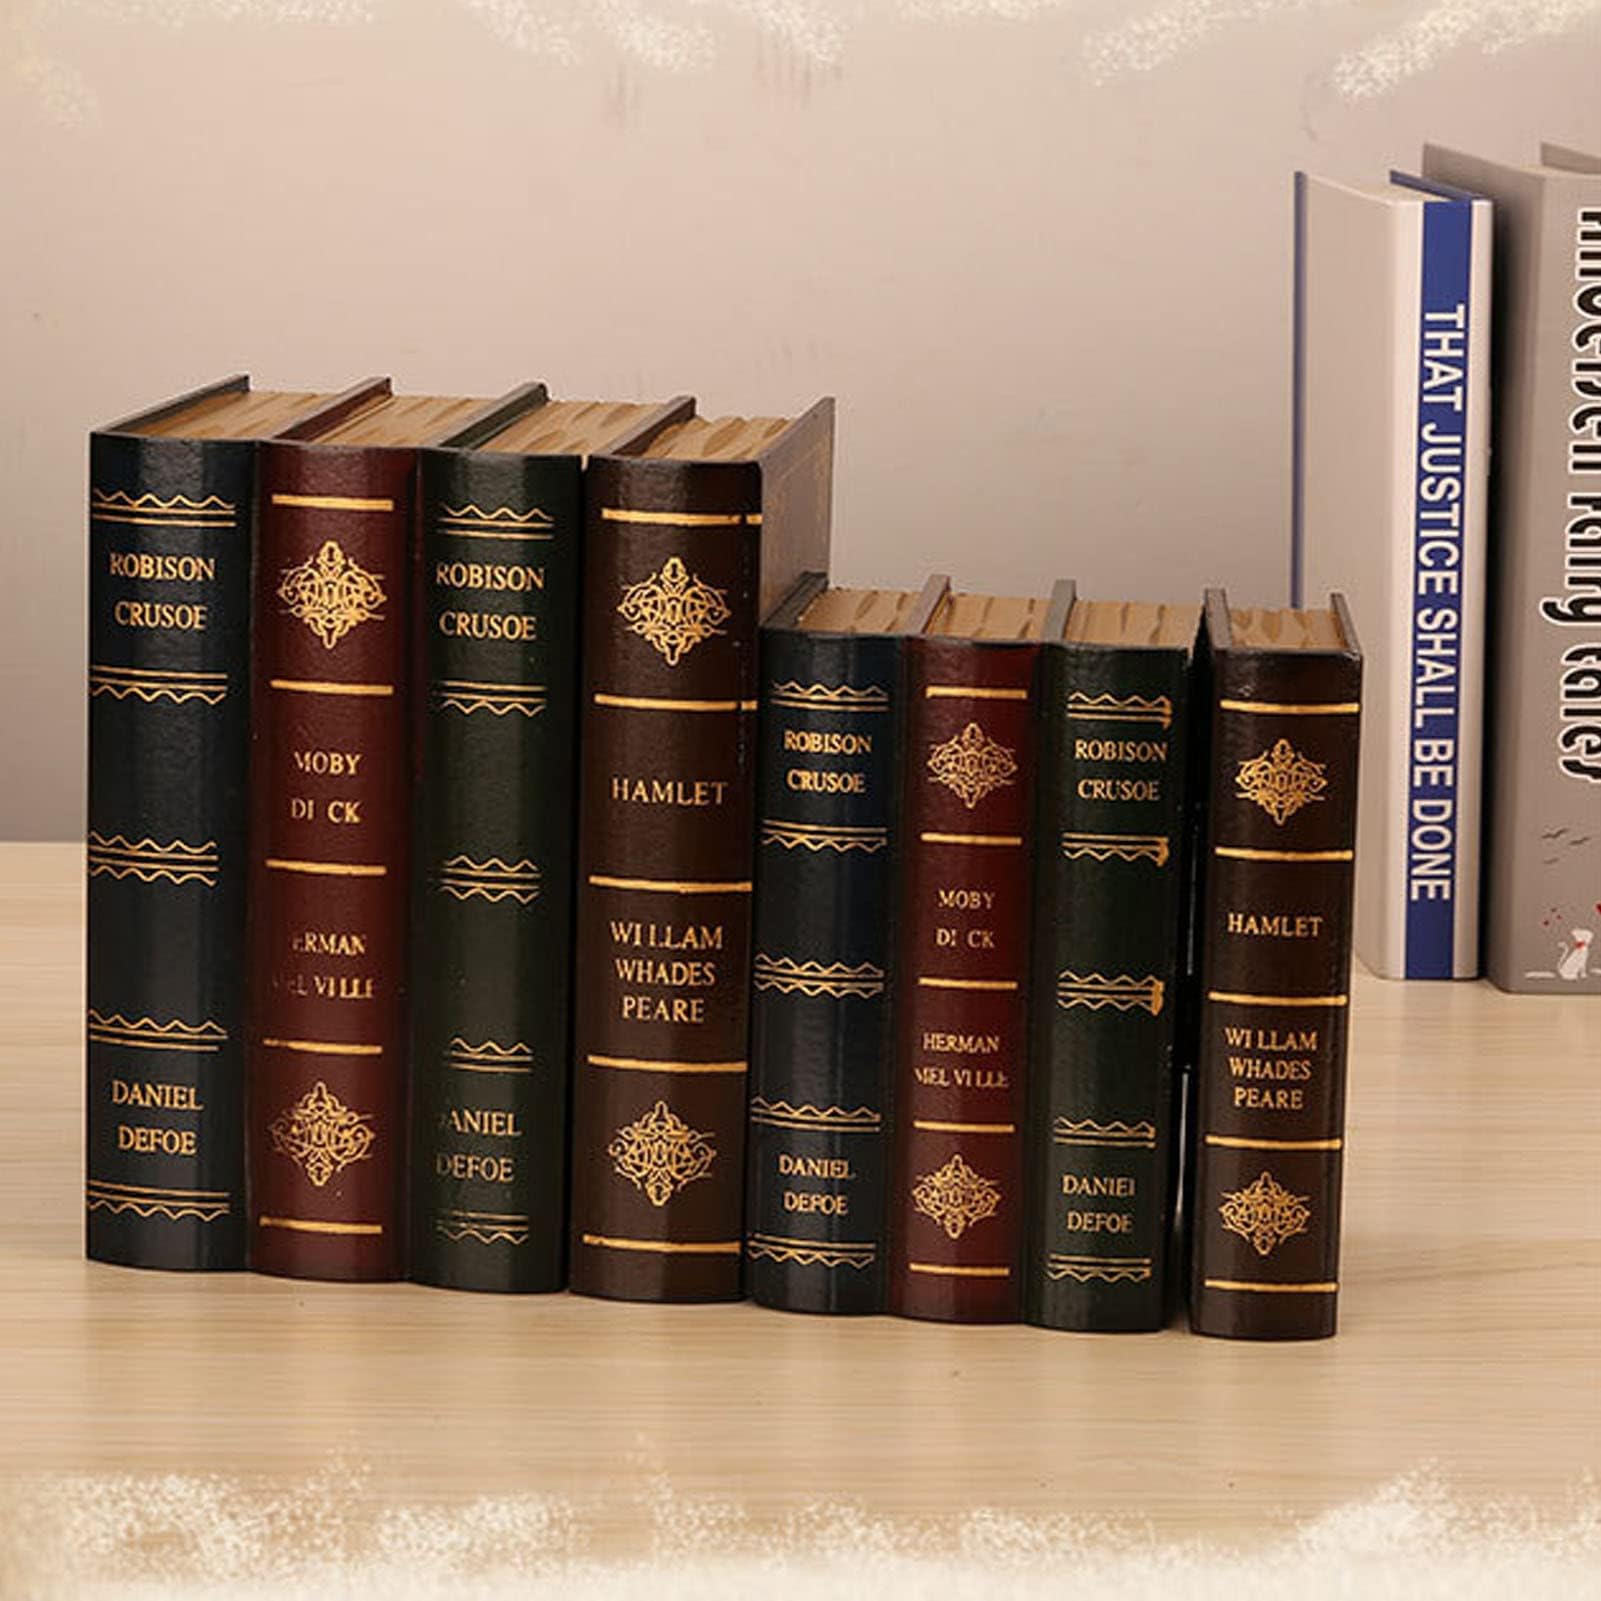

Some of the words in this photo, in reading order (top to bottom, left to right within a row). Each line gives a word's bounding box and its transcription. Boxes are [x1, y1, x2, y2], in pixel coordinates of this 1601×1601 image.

[1423, 304, 1465, 412] THAT
[1416, 422, 1462, 596] JUSTICE
[110, 552, 216, 582] ROBISON
[436, 562, 544, 592] ROBISON
[114, 600, 208, 631] CRUSOE
[438, 611, 537, 641] CRUSOE
[1414, 608, 1458, 729] SHALL
[783, 729, 872, 755] ROBISON
[1074, 738, 1168, 763] ROBISON
[293, 750, 362, 776] MOBY
[1412, 738, 1456, 787] BE
[611, 776, 728, 807] HAMLET
[786, 768, 865, 794] CRUSOE
[1076, 778, 1160, 802] CRUSOE
[1410, 798, 1454, 901] DONE
[937, 888, 995, 910] MOBY
[1226, 911, 1323, 938] HAMLET
[614, 957, 716, 987] WHADES
[621, 995, 705, 1023] PEARE
[922, 1032, 1000, 1055] HERMAN
[1228, 1055, 1313, 1081] WHADES
[111, 1079, 204, 1111] DANIEL
[1233, 1085, 1304, 1110] PEARE
[440, 1108, 523, 1137] ANIEL
[118, 1124, 198, 1156] DEFOE
[435, 1152, 515, 1183] DEFOE
[778, 1153, 855, 1180] DANIEL
[783, 1190, 849, 1216] DEFOE
[1066, 1209, 1134, 1233] DEFOE
